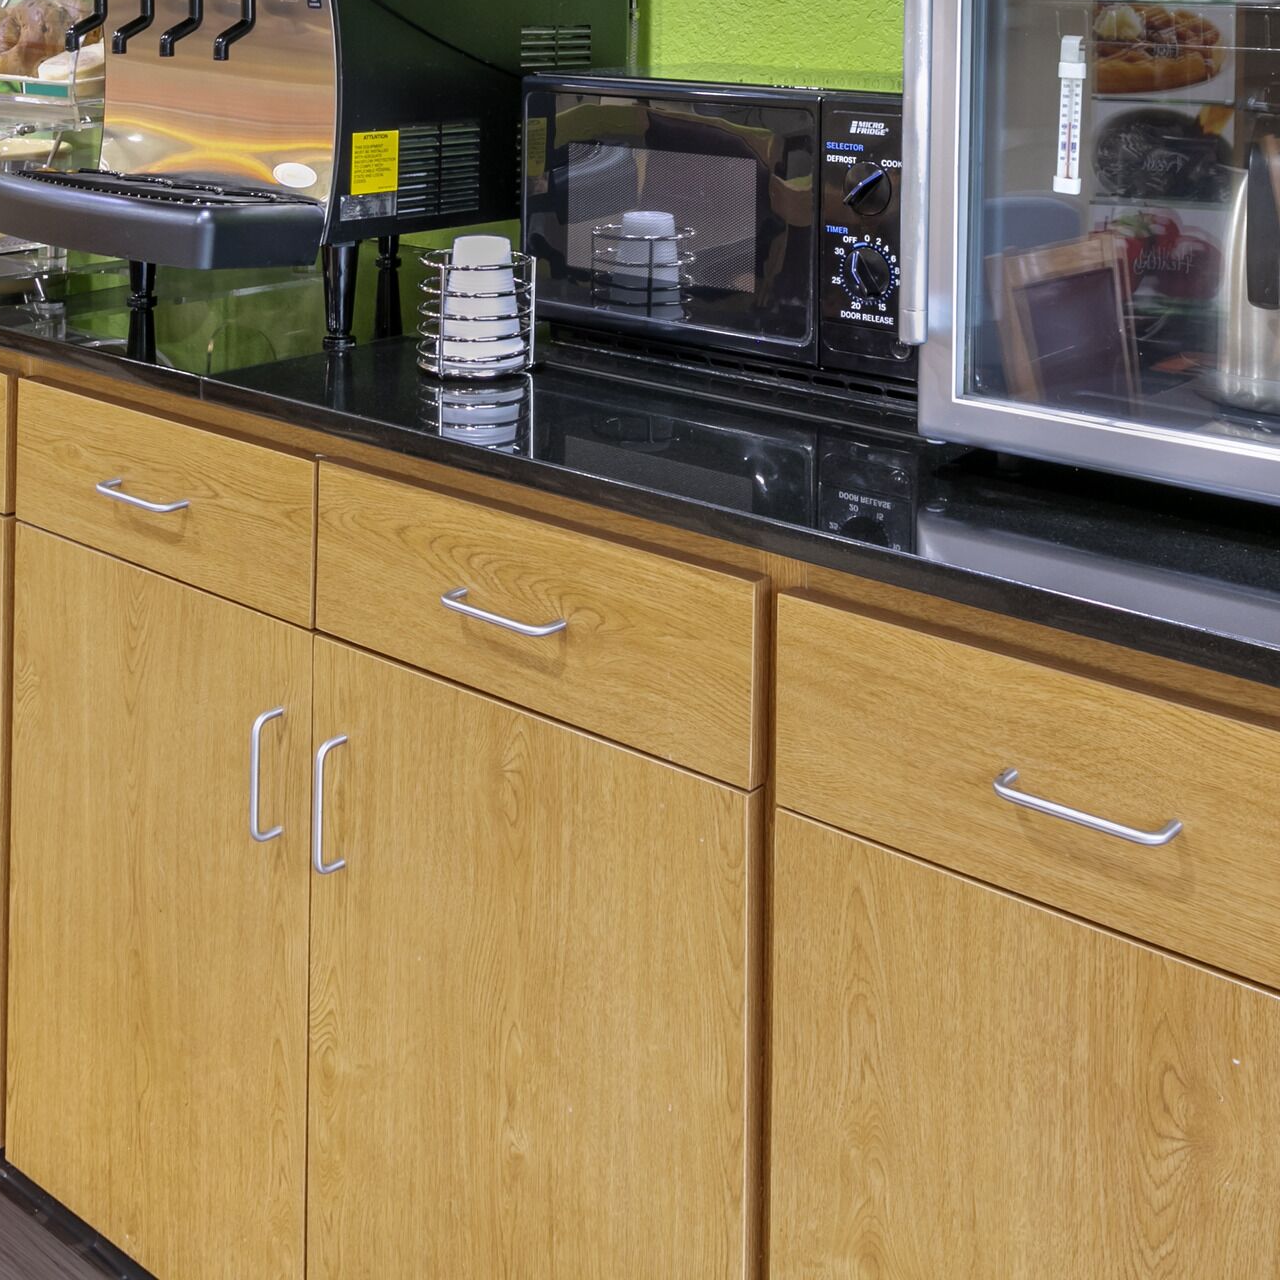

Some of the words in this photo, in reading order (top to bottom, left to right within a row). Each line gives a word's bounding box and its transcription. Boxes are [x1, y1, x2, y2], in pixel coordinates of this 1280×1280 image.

[857, 120, 885, 129] MICRO
[826, 141, 864, 151] SELECTOR
[826, 154, 857, 164] DEFROST
[825, 225, 848, 234] TIMER
[842, 235, 858, 244] OFF
[876, 237, 881, 245] 2
[890, 255, 897, 263] 6
[894, 267, 900, 275] 8
[831, 276, 841, 284] 25
[851, 302, 861, 310] 20
[878, 303, 887, 311] 15
[840, 310, 861, 320] DOOR
[862, 313, 894, 325] RELEASE
